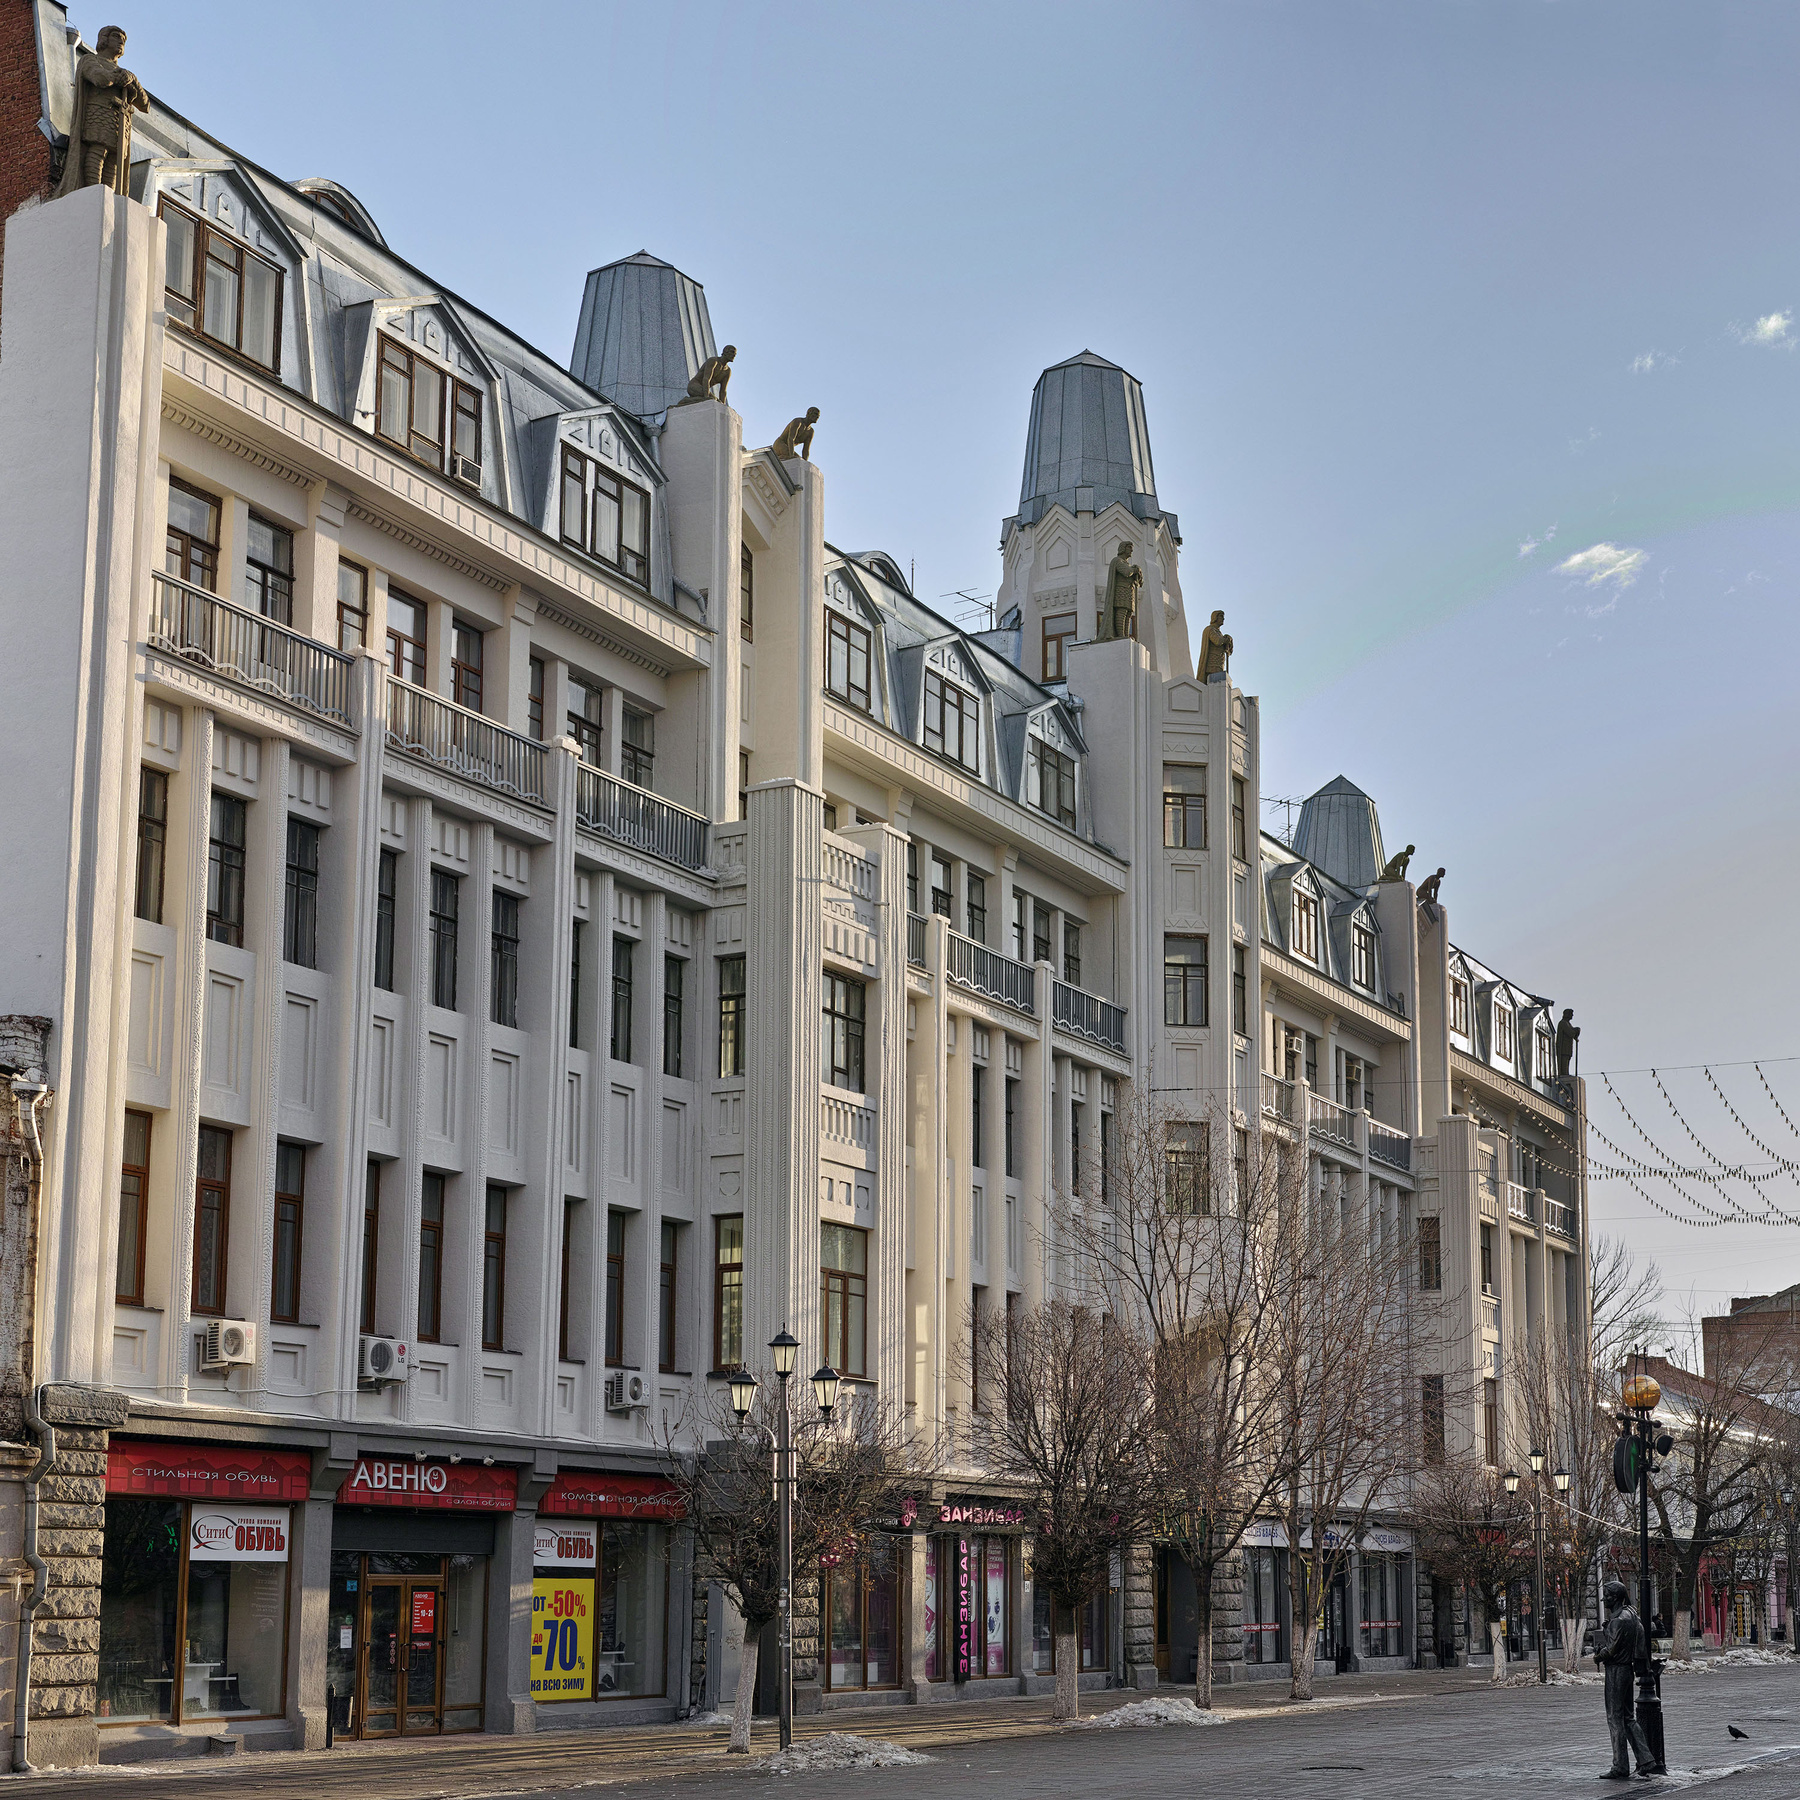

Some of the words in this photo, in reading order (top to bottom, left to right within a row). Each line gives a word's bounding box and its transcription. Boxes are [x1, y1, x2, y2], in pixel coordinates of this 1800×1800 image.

[132, 1467, 219, 1480] стильная
[225, 1471, 277, 1484] обувь
[351, 1461, 447, 1493] АВЕНЮ
[257, 1518, 282, 1526] КОМПАНИЙ
[235, 1525, 286, 1552] ОБУВЬ
[557, 1536, 594, 1558] ОБУВЬ
[548, 1589, 586, 1617] -50%
[959, 1540, 968, 1673] ЗАНЗИБАР
